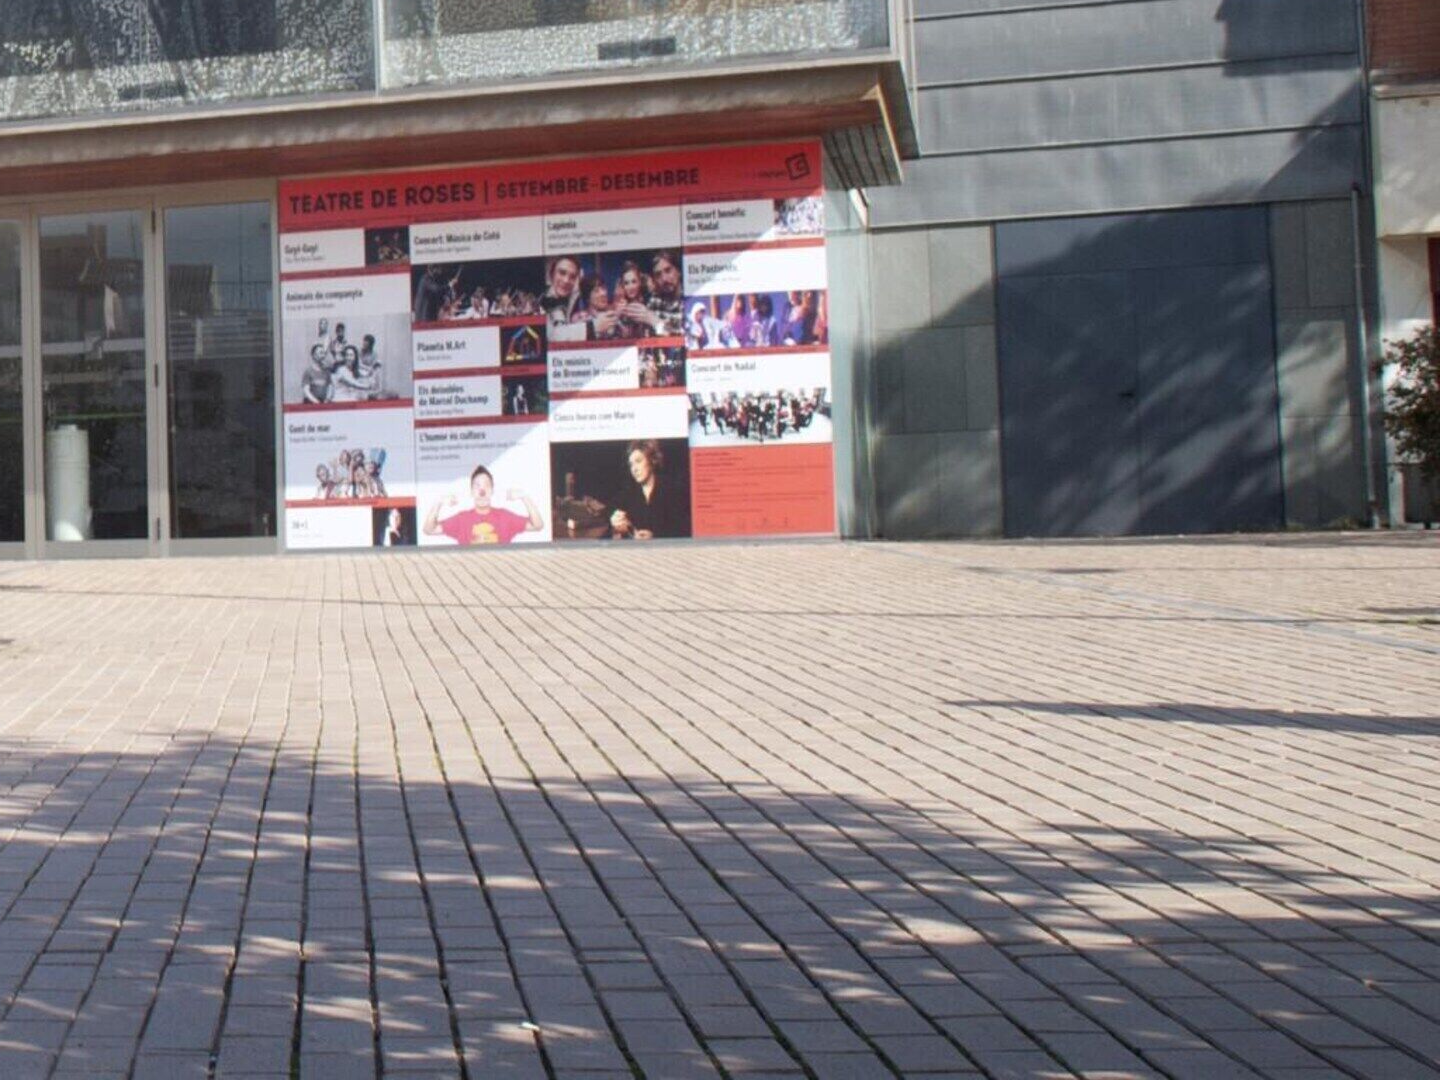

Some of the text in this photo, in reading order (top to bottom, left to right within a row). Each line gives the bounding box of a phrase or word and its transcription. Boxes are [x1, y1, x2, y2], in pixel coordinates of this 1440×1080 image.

[289, 190, 364, 215] TEATRE
[371, 188, 398, 208] DE
[404, 182, 475, 207] ROSES
[496, 176, 588, 200] SETEMBRE
[600, 168, 700, 192] DESEMBRE
[686, 210, 716, 220] Concert
